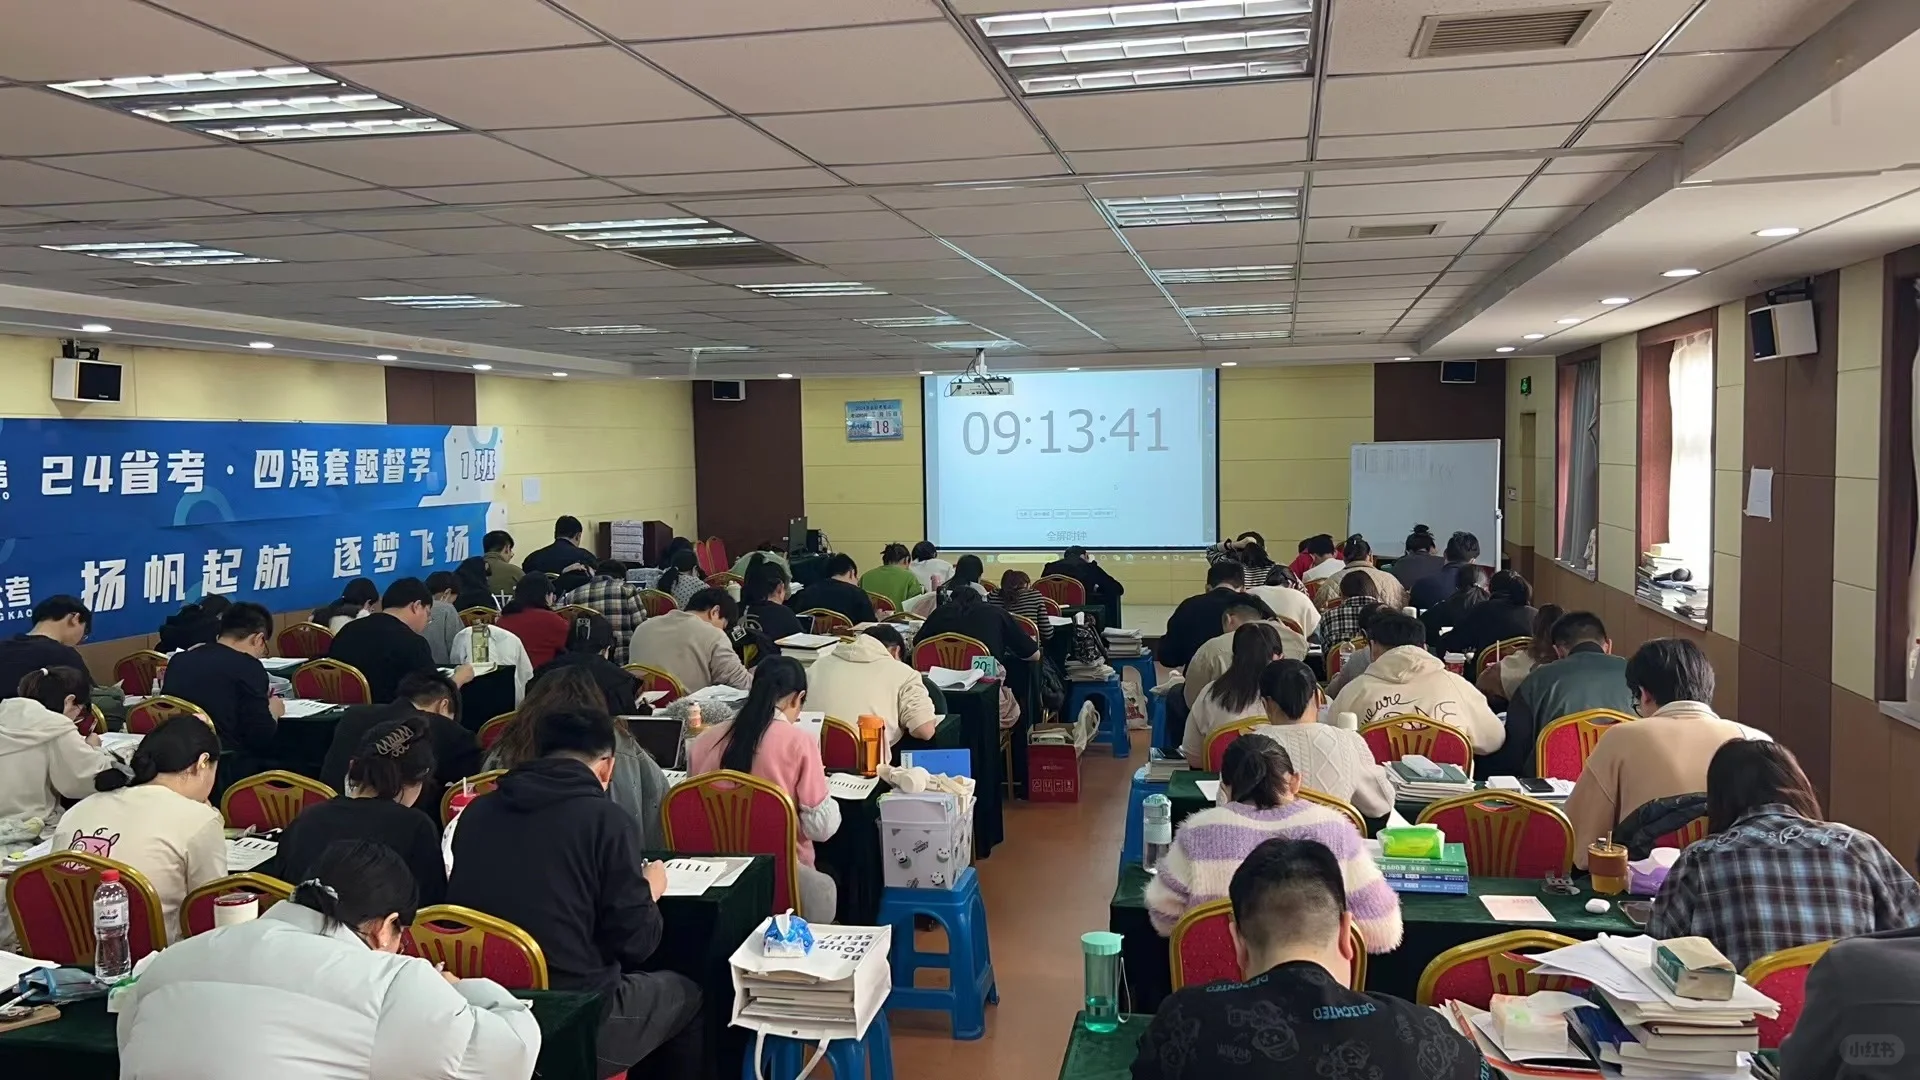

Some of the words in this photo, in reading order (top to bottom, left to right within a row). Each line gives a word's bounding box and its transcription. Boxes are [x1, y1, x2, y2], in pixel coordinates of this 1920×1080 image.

[876, 421, 889, 434] 18
[963, 408, 1169, 455] 09:13:41
[460, 448, 497, 482] 1班
[1046, 531, 1087, 541] 全屏时钟
[80, 542, 292, 613] 扬帆起航
[333, 524, 470, 580] 逐梦飞扬
[0, 576, 31, 608] 考
